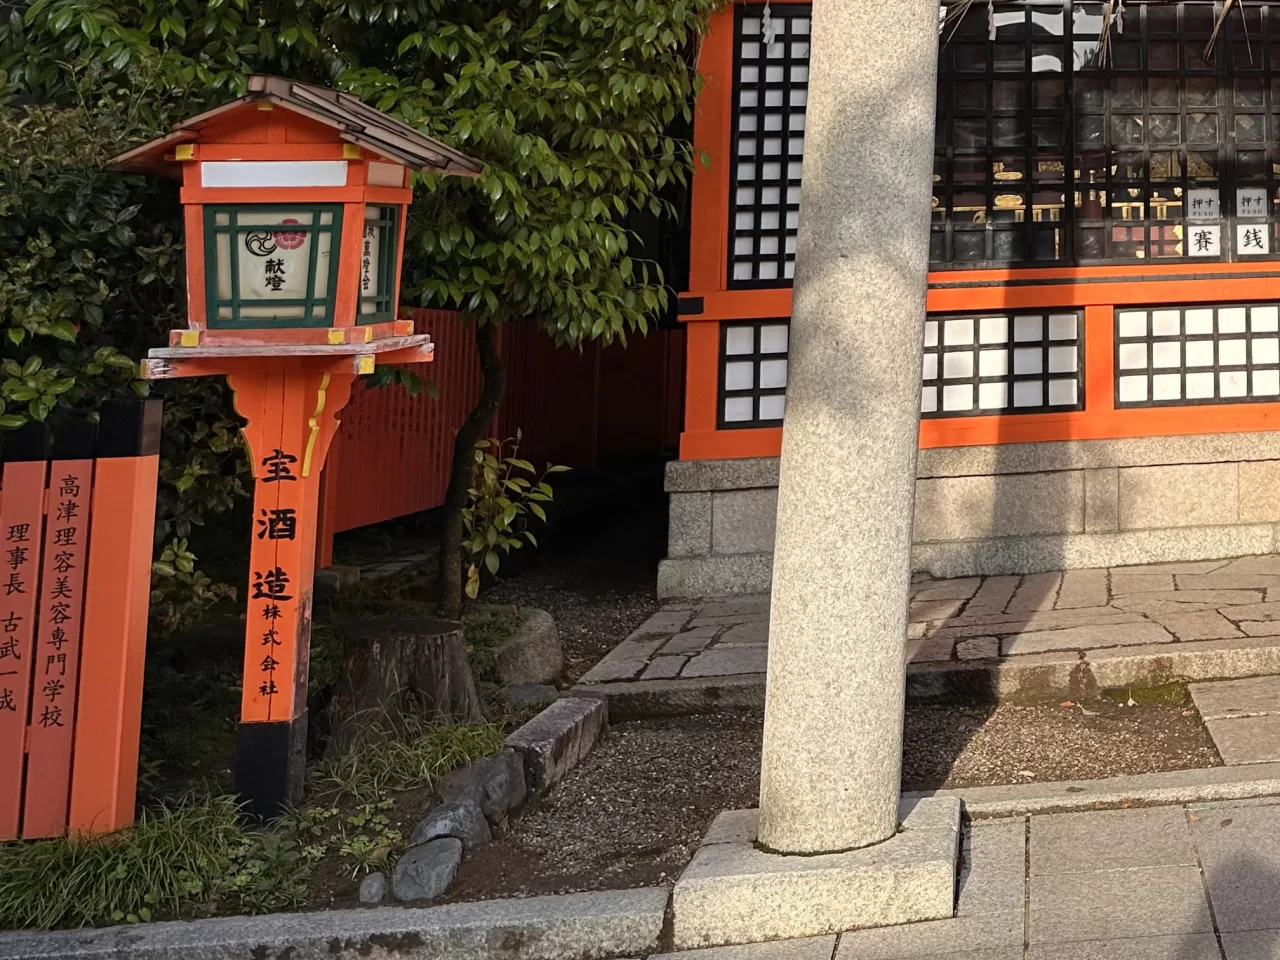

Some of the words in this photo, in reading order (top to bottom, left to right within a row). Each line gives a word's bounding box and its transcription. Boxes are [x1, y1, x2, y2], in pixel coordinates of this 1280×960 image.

[1192, 198, 1214, 209] 押す
[1241, 196, 1263, 208] 押す
[1193, 229, 1214, 252] 賽
[1243, 228, 1264, 249] 銭
[264, 257, 286, 292] 献燈
[252, 448, 298, 602] 宝酒造
[3, 523, 30, 596] 理事長
[39, 474, 80, 728] 高津理容美容専門学校
[258, 604, 283, 696] 株式会社
